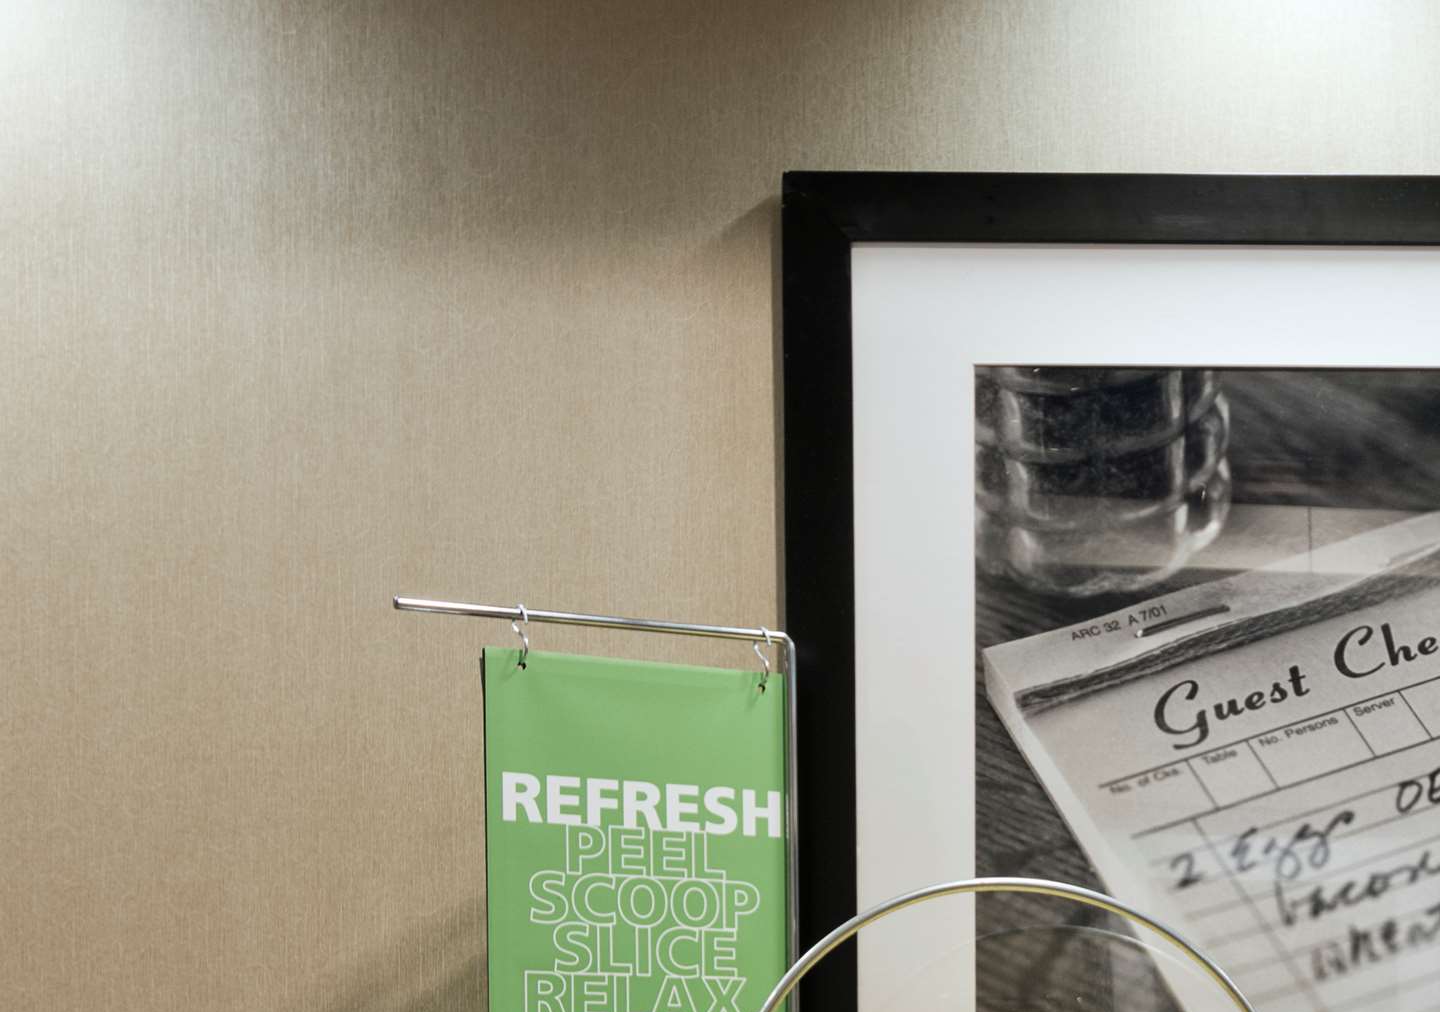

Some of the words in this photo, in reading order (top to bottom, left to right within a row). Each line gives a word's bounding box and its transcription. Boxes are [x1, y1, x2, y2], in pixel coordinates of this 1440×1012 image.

[1071, 625, 1102, 641] ARC
[1104, 620, 1121, 633] 32
[1127, 614, 1139, 626] A
[1140, 604, 1168, 621] 7/01
[1153, 664, 1312, 751] Guest
[1352, 697, 1396, 718] Server
[1259, 731, 1282, 748] No.
[1284, 715, 1339, 741] Persons
[1201, 748, 1239, 767] Table
[502, 771, 782, 838] REFRESH
[565, 823, 727, 880] PEEL
[1169, 853, 1202, 890] 2
[529, 869, 761, 931] SCOOP
[553, 921, 738, 978] SLICE
